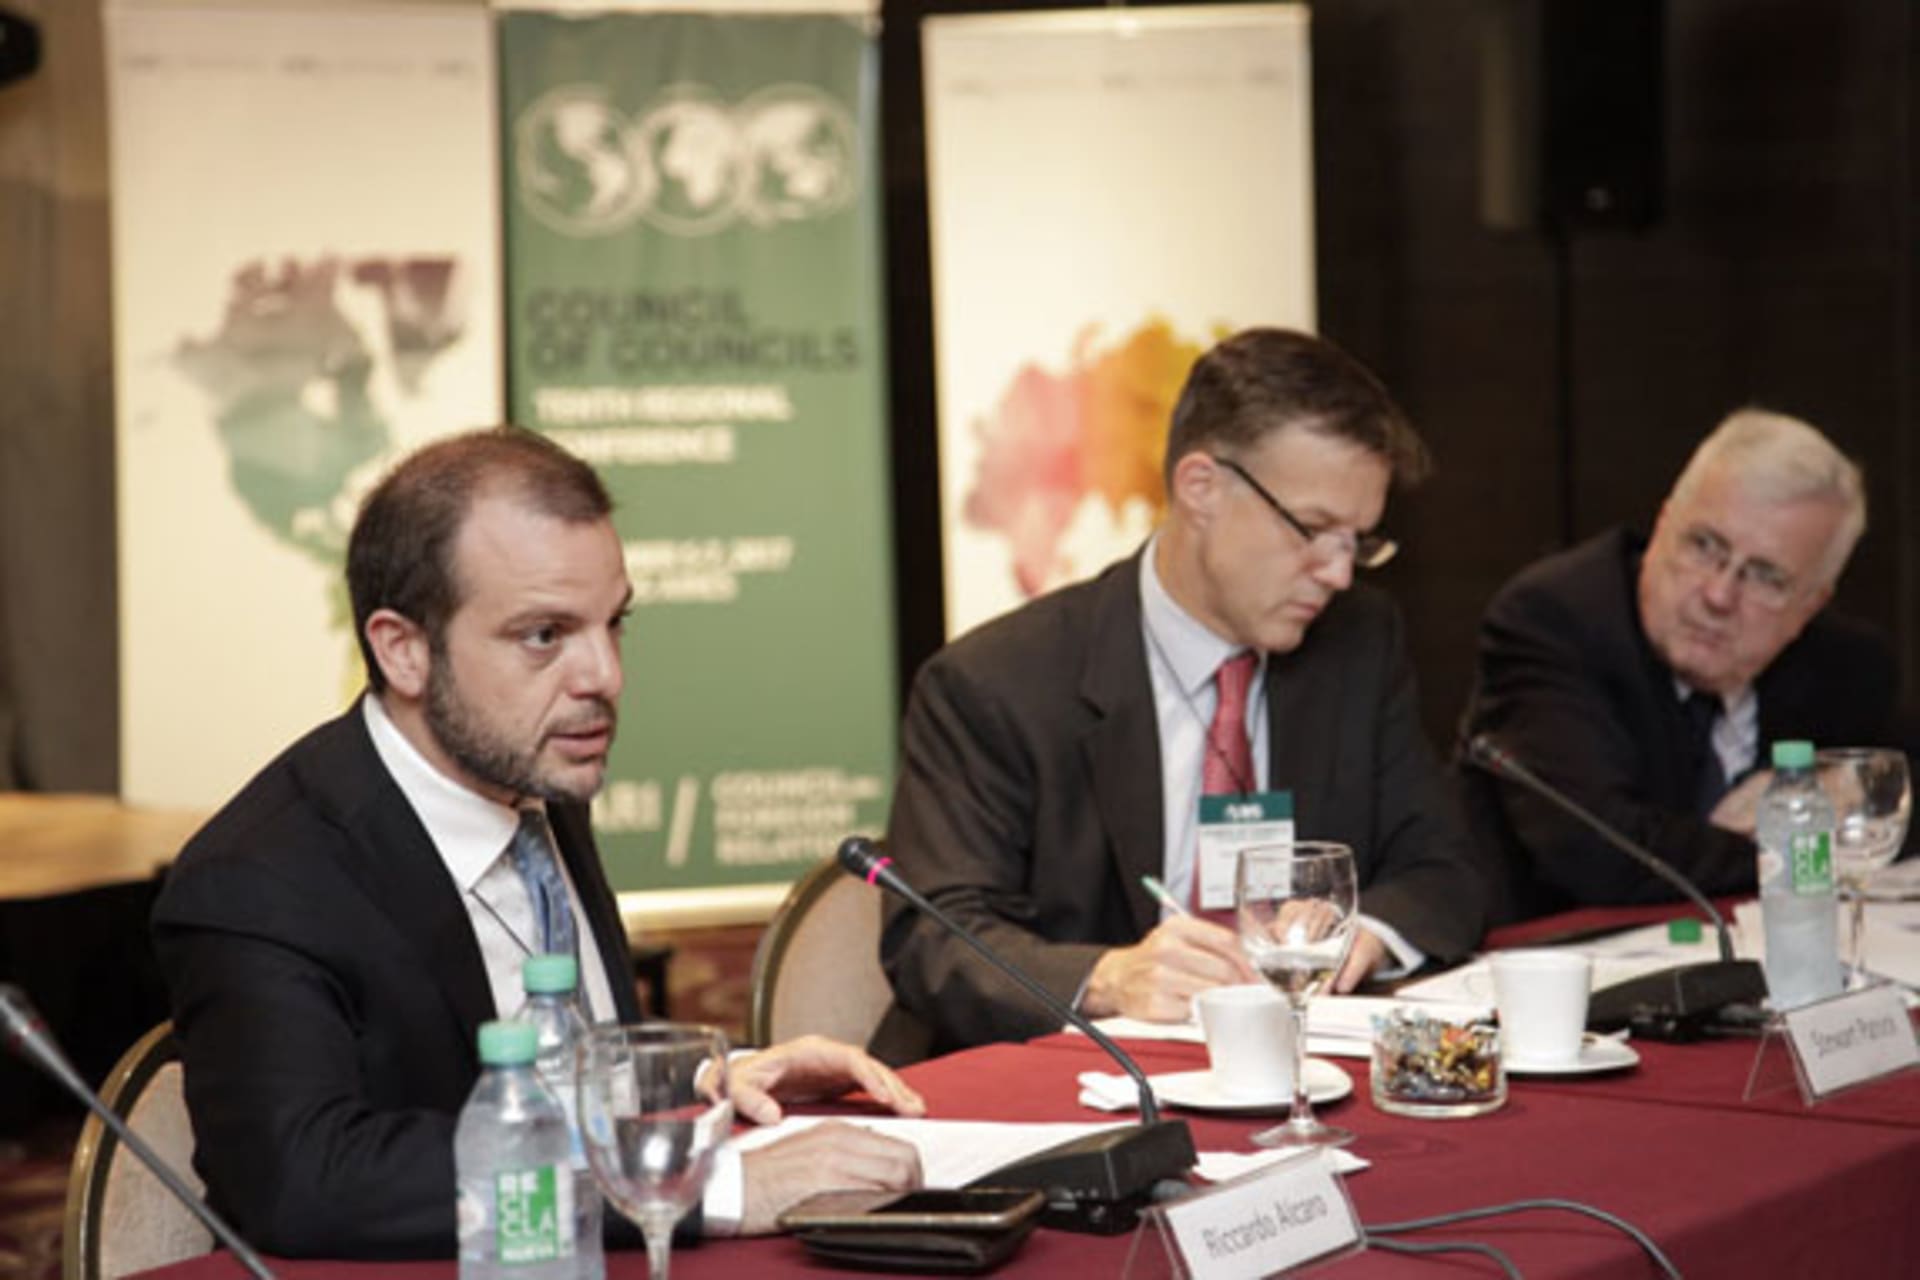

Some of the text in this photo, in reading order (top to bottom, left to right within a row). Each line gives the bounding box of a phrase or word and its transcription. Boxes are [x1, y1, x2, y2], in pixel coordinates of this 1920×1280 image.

[527, 289, 748, 326] COUNCIL
[527, 328, 861, 373] OF COUNCILS
[540, 427, 734, 462] ONFERENCE
[1202, 1206, 1277, 1258] Riccardo
